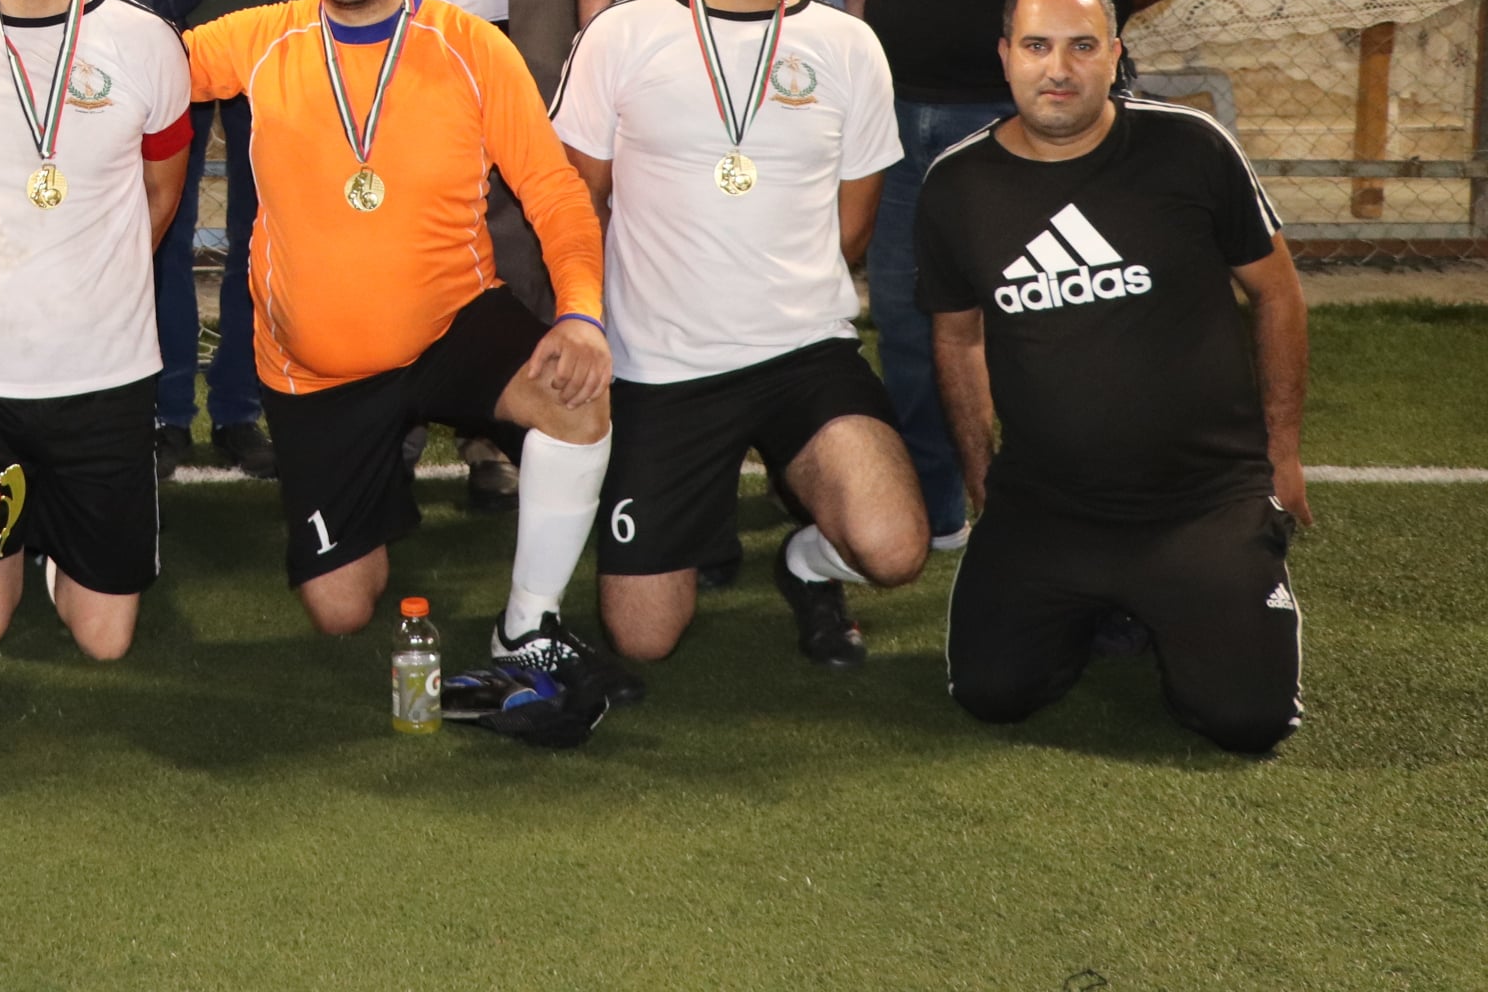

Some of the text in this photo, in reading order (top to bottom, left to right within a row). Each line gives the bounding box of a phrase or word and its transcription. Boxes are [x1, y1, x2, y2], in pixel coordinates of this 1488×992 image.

[994, 264, 1152, 314] adidas
[307, 509, 338, 555] 1
[611, 498, 636, 543] 6
[1266, 598, 1294, 610] adida
